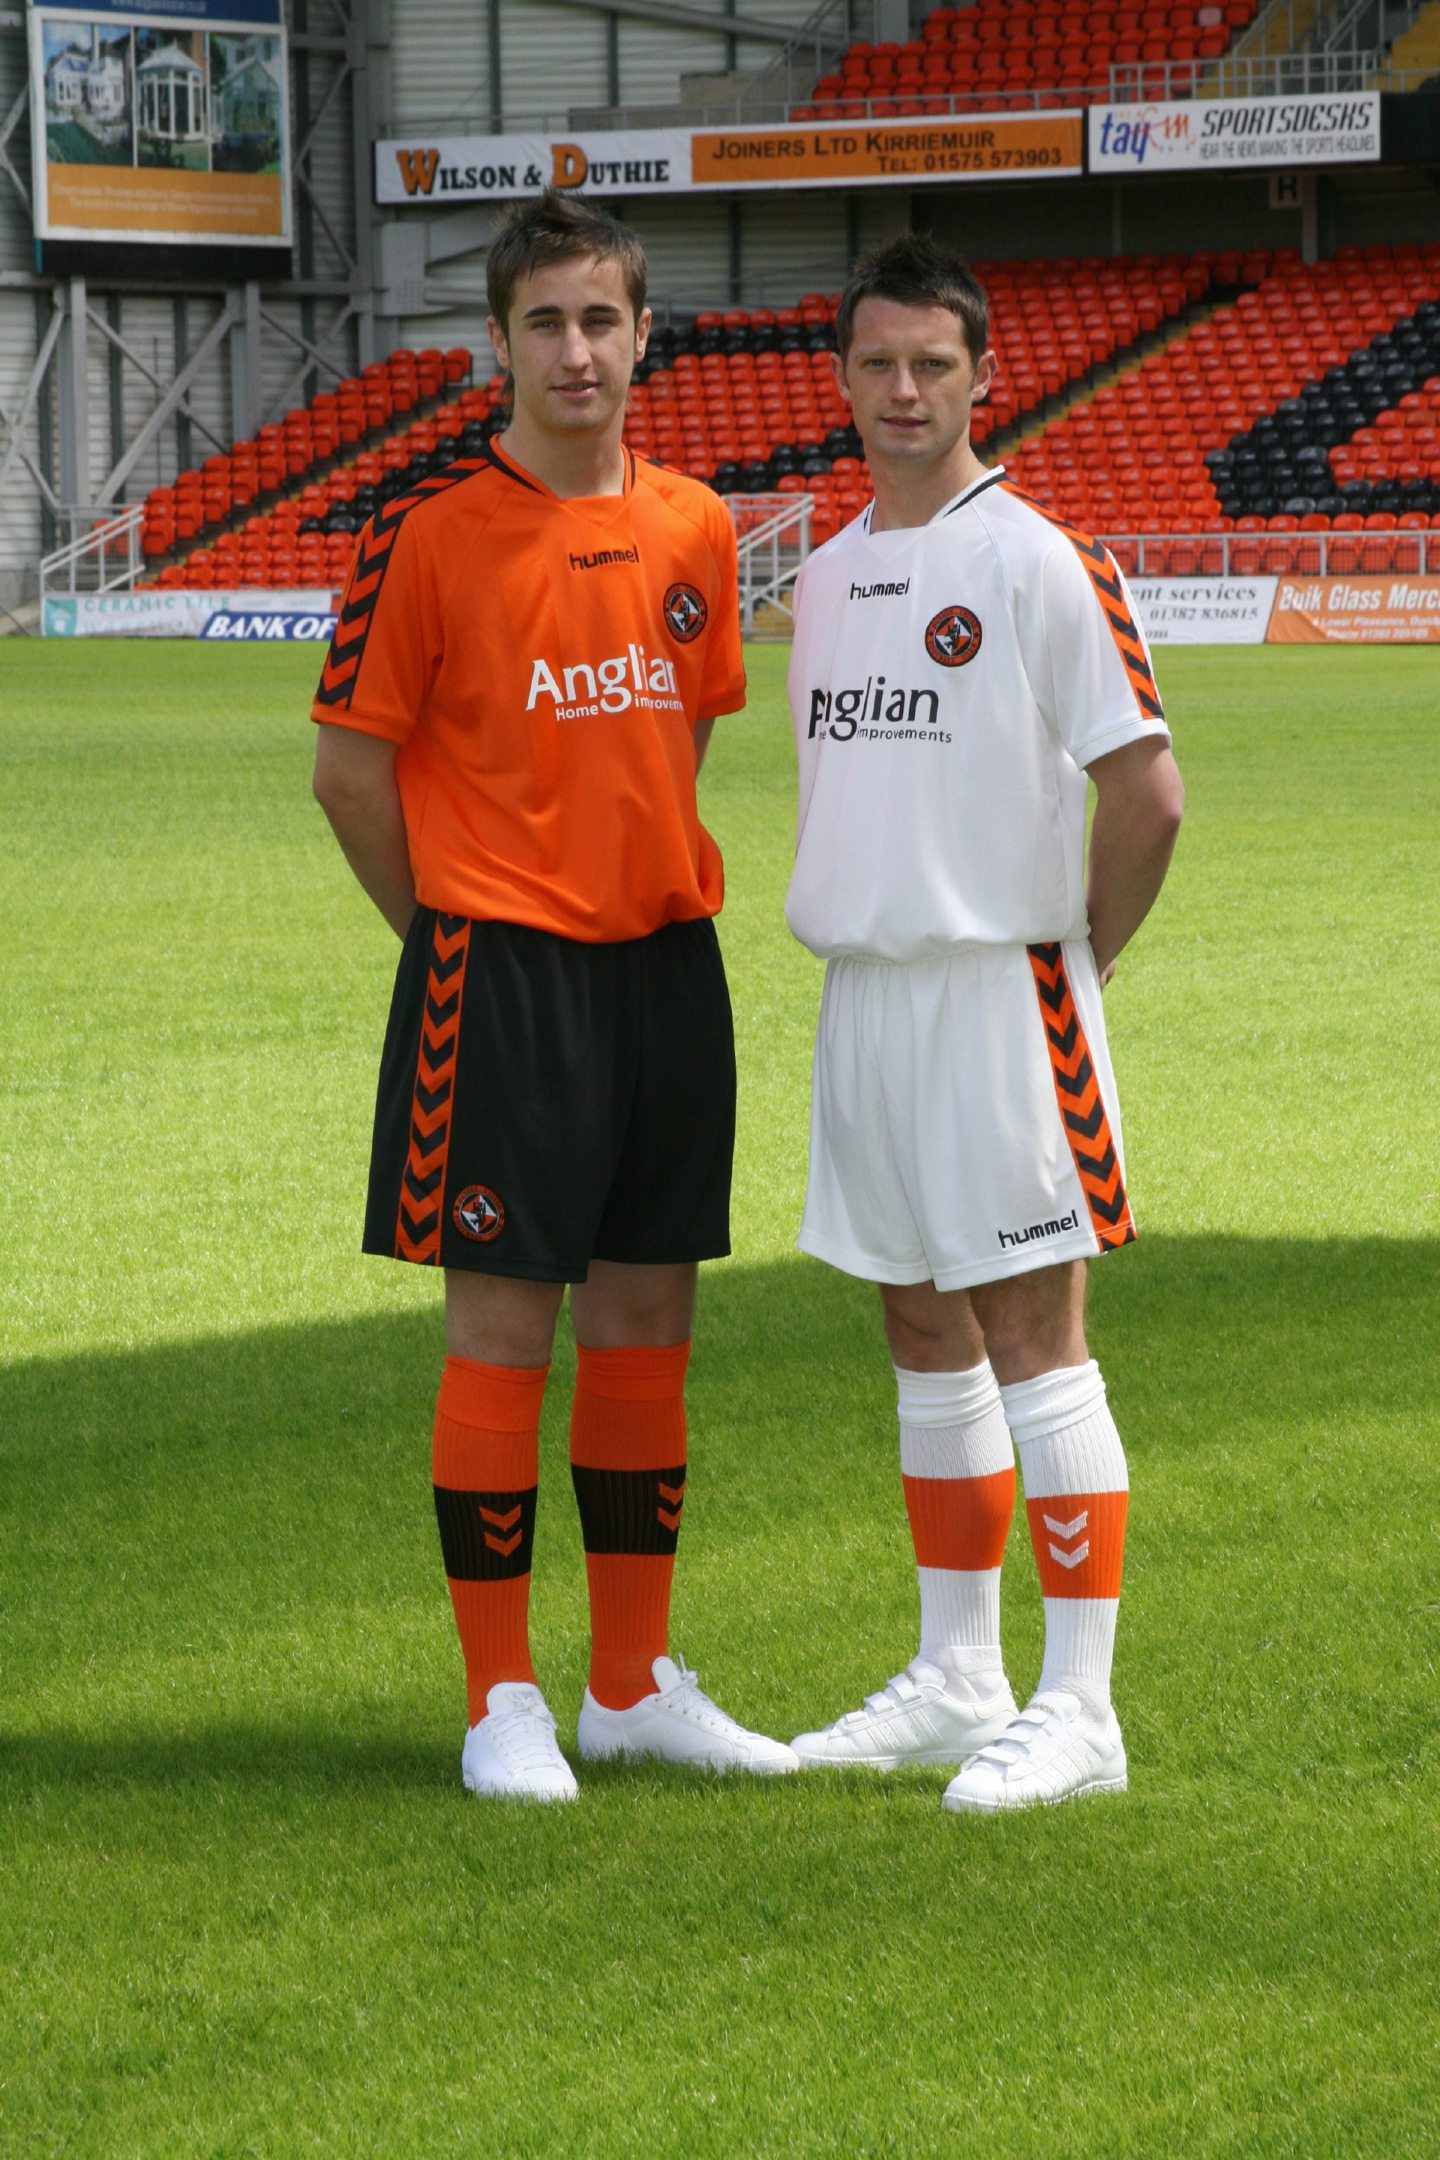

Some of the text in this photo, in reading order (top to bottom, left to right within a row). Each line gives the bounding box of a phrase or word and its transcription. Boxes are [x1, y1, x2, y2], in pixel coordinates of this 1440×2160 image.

[1201, 101, 1373, 137] SPORTSDESKS
[713, 130, 995, 160] JOINERS LTD KIRRIEMUIR
[1101, 111, 1150, 164] tay
[396, 143, 670, 196] WILSON & DUTHIE
[878, 148, 1062, 174] TEL: 01575 573903
[569, 545, 640, 571] hummel
[850, 577, 910, 600] hummel
[1170, 583, 1257, 601] services
[1328, 584, 1382, 611] Glass
[84, 598, 175, 613] CERAMIC
[1151, 607, 1259, 621] 01382 836815
[206, 615, 294, 639] BANK
[293, 616, 338, 640] OF
[555, 703, 599, 722] Home
[857, 726, 952, 744] improvements
[998, 1209, 1079, 1249] hummel
